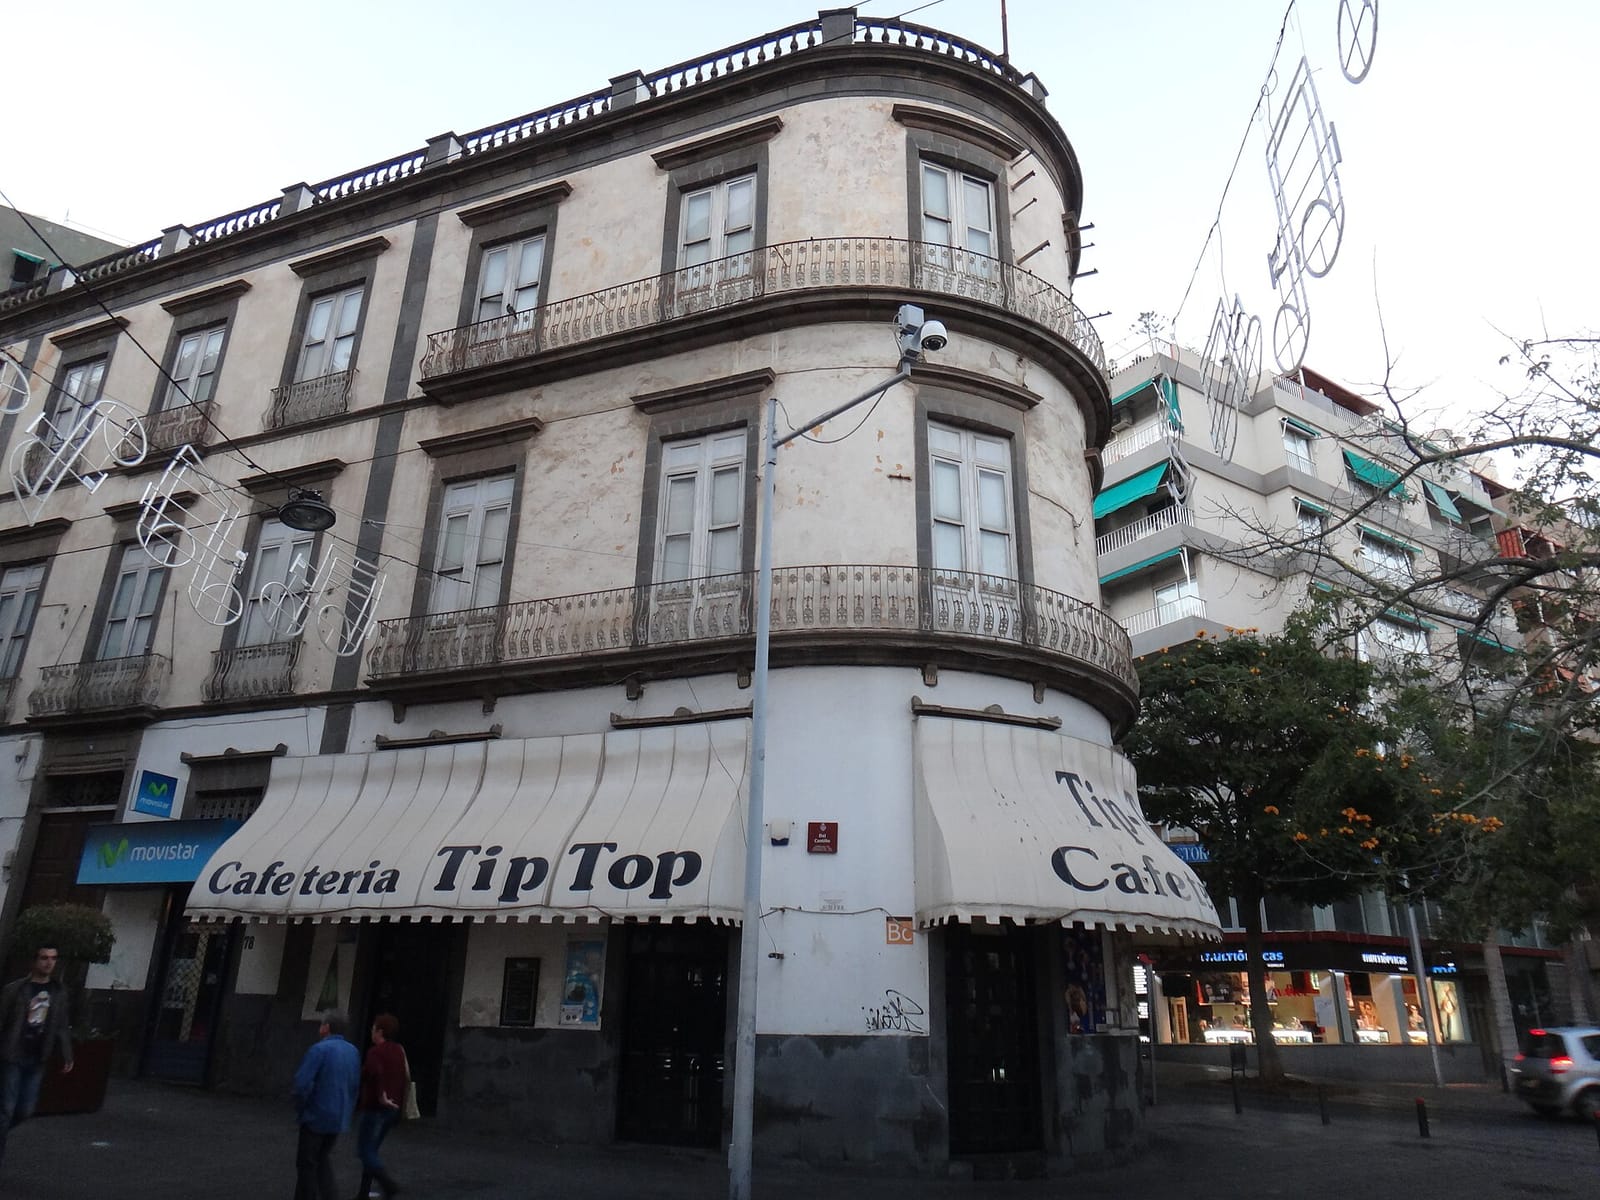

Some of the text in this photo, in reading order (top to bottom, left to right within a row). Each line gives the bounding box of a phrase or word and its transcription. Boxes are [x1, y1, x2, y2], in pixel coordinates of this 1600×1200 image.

[140, 797, 170, 809] movistar
[130, 842, 199, 861] movistar
[208, 842, 702, 902] Cafeteria Tip Top
